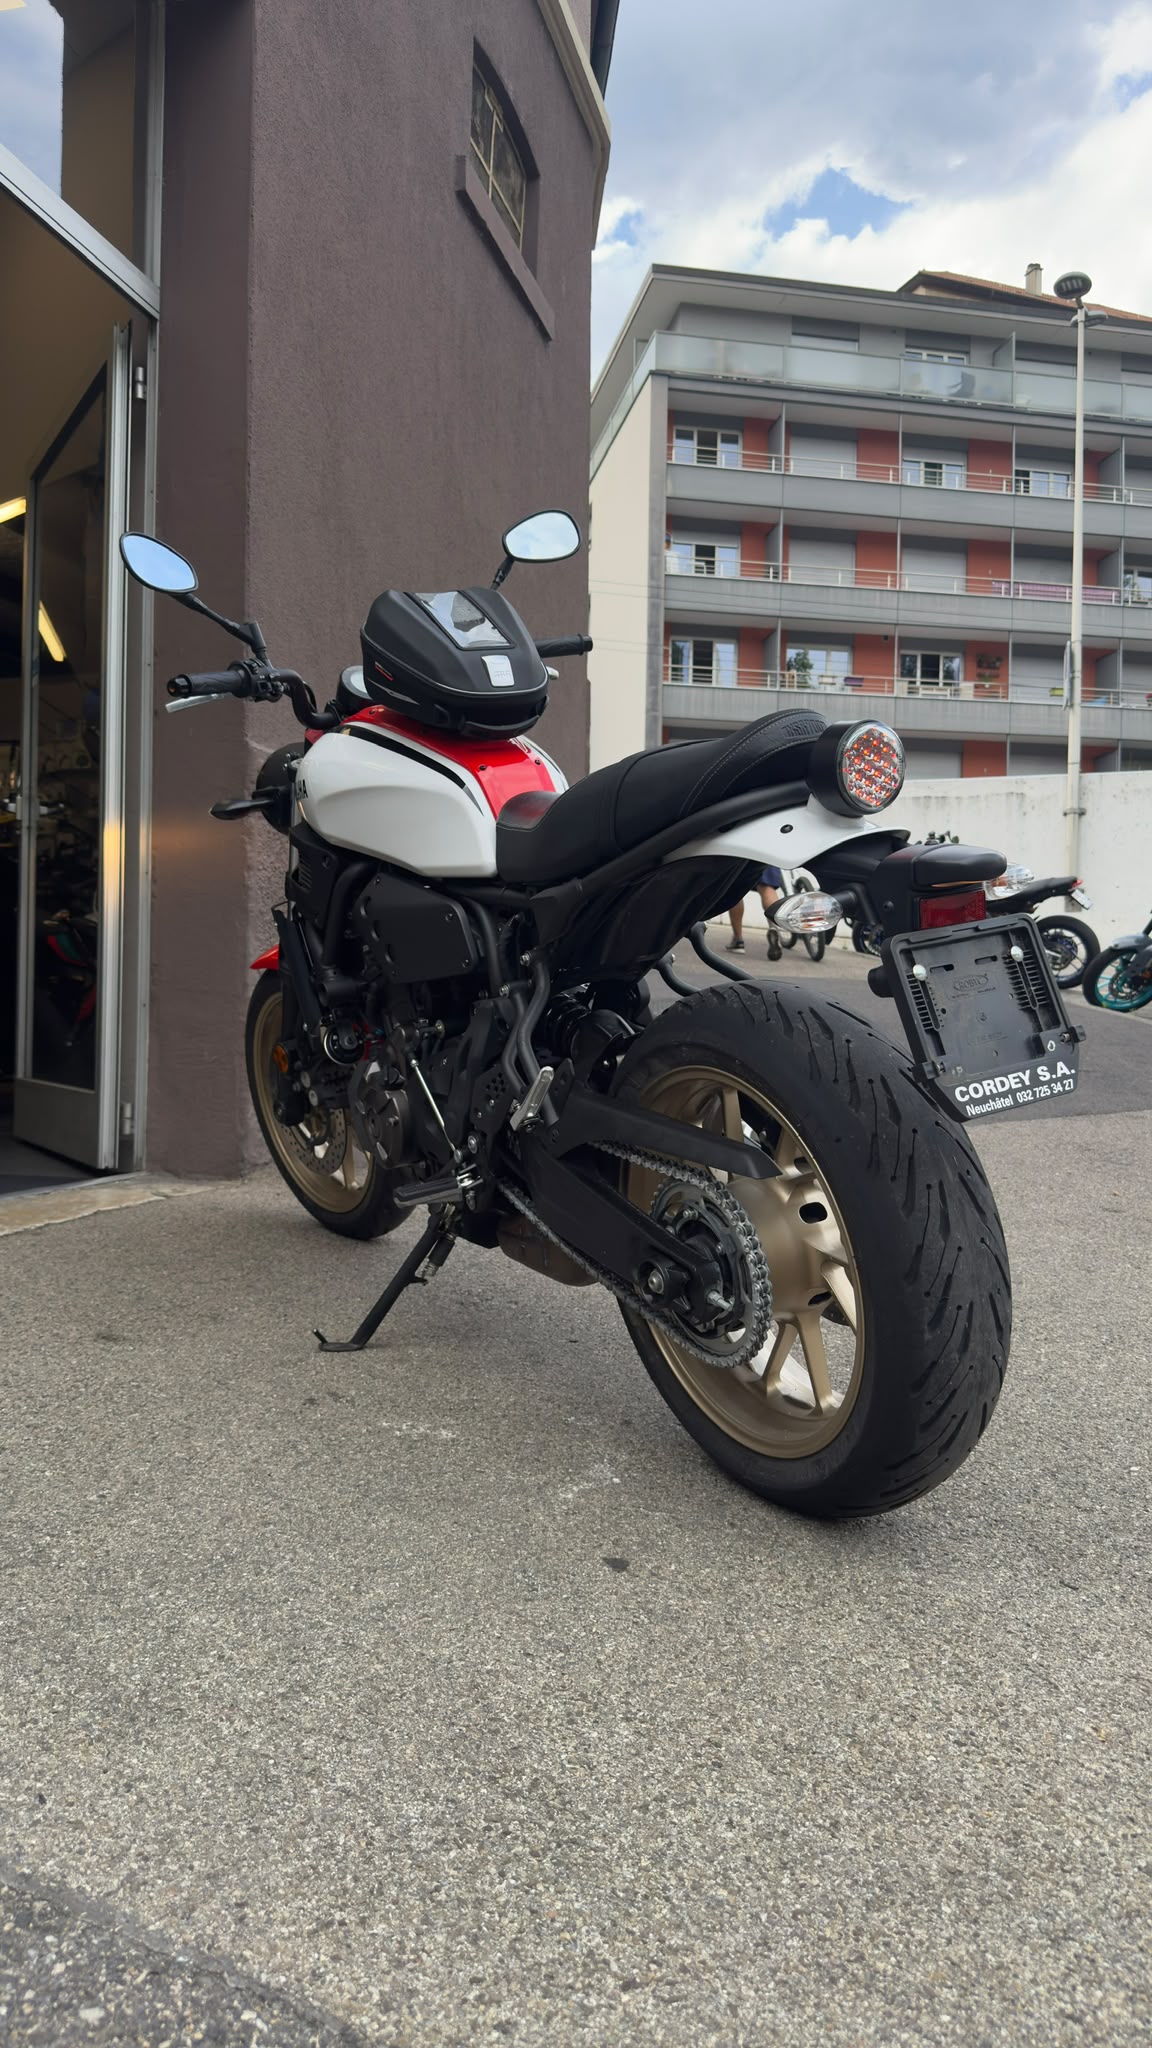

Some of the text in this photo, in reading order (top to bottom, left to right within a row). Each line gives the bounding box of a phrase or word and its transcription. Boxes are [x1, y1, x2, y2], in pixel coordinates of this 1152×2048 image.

[954, 1069, 1031, 1102] CORDEY
[1036, 1061, 1076, 1081] S.A.
[965, 1078, 1074, 1117] Neuchâtel 032 725 34 27
